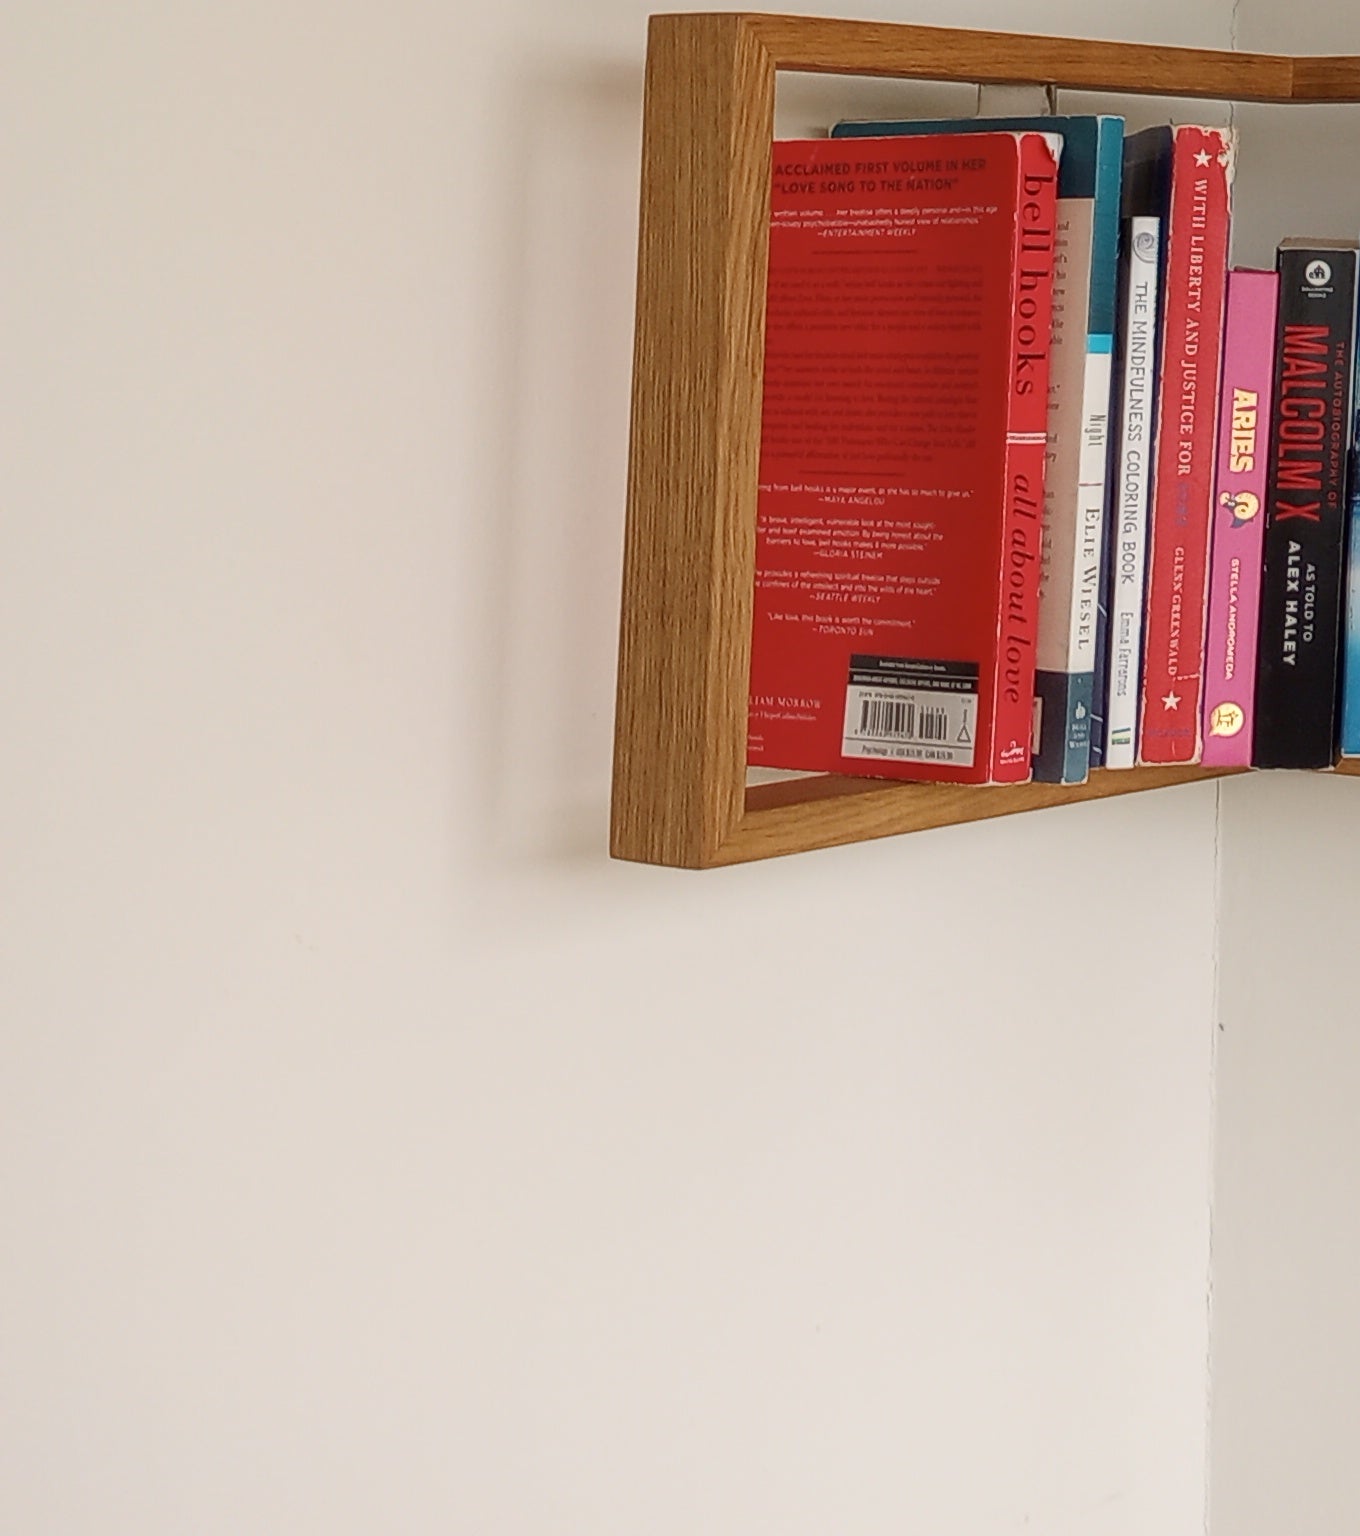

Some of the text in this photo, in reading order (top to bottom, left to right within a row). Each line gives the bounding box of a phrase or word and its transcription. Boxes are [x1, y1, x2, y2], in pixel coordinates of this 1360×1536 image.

[775, 163, 850, 176] ACCLAIMED
[855, 162, 888, 174] FIRST
[893, 161, 942, 173] VOLUME
[819, 181, 855, 193] SONG
[860, 181, 875, 192] TO
[880, 180, 901, 192] THE
[1190, 179, 1208, 229] WITH
[1015, 172, 1056, 397] bell hooks
[1187, 235, 1205, 313] LIBERTY
[1183, 318, 1199, 356] AND
[1121, 282, 1148, 585] THE MINDFULNESS COLORING BOOK
[1180, 359, 1197, 435] JUSTICE
[1230, 387, 1259, 474] ARIES
[1276, 324, 1330, 491] MALCOLM
[1326, 341, 1346, 509] THE AUTOBIOGRAPHY OF
[1177, 441, 1193, 477] FOR
[1275, 500, 1321, 522] X
[1004, 474, 1037, 703] all about love
[1078, 507, 1101, 650] ELIE WIESEL
[1168, 546, 1185, 677] GLENN GREENWALD
[1225, 558, 1240, 680] STELLA ANDROMEDA
[1282, 540, 1301, 666] ALEX HALEY
[1302, 563, 1316, 642] AS TOLD TO
